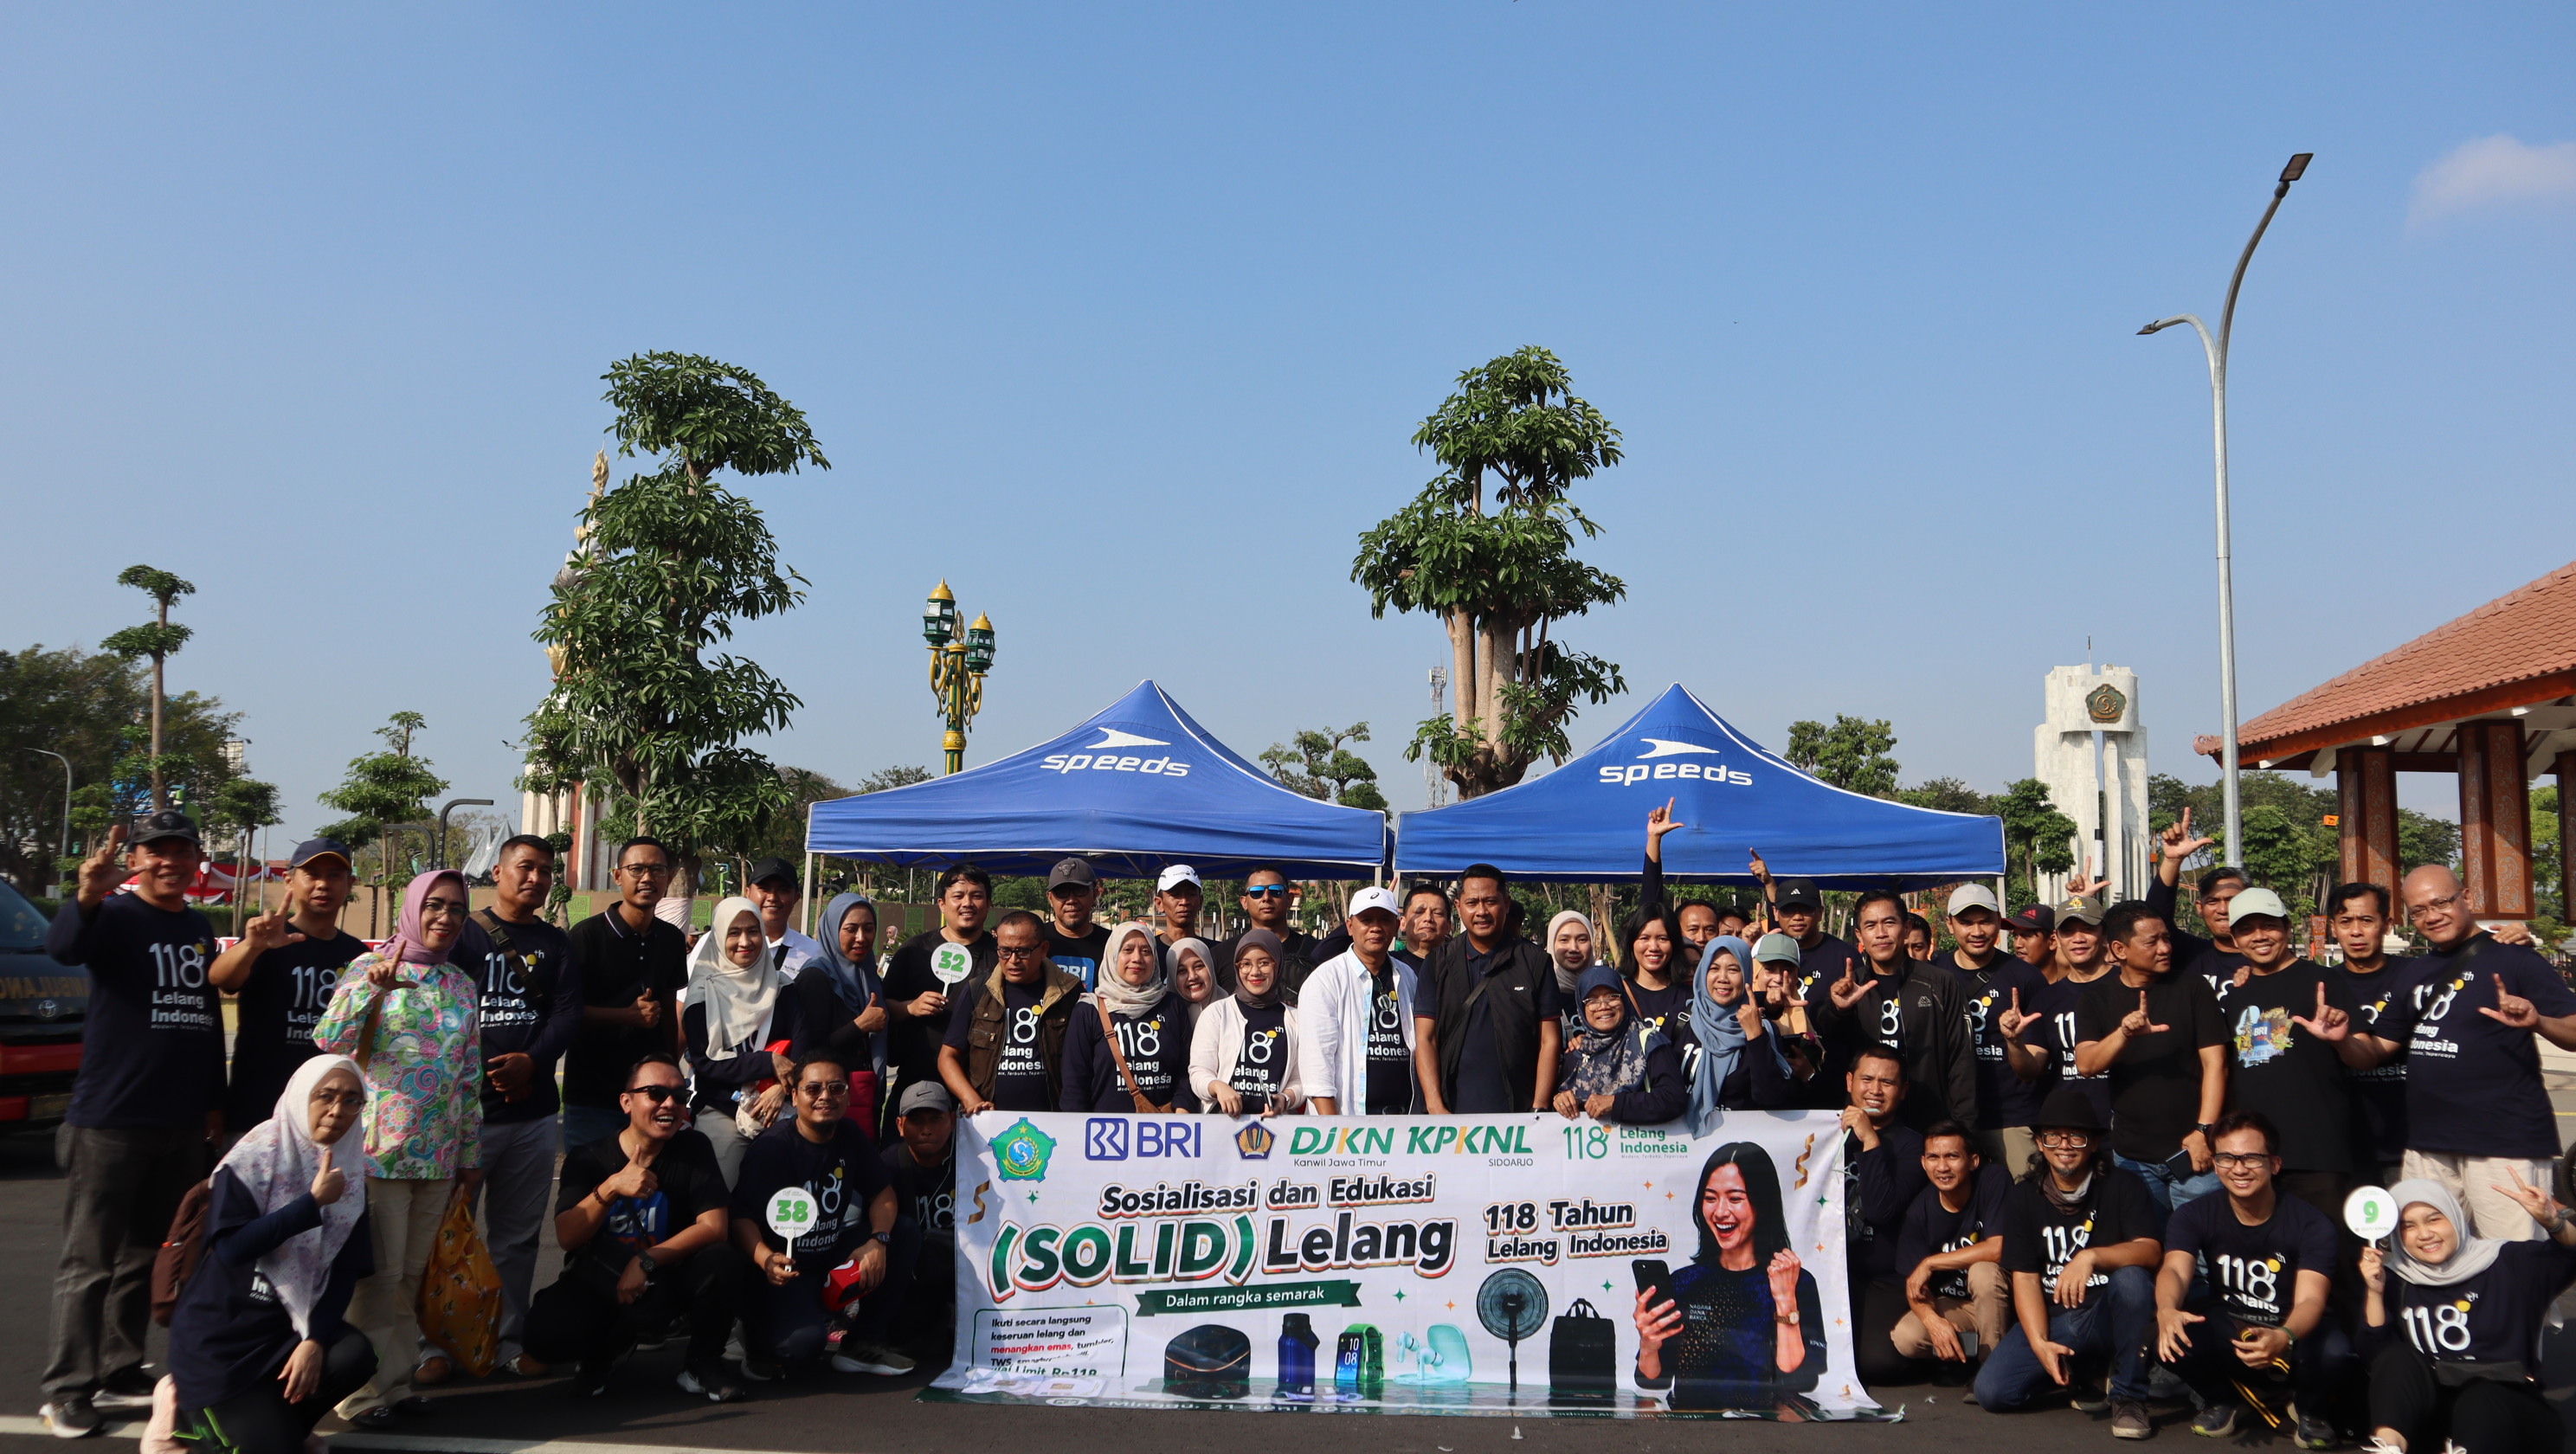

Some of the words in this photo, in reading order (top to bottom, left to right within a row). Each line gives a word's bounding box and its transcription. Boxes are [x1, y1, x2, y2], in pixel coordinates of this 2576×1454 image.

[1040, 754, 1192, 777] speeds
[1599, 763, 1753, 787] speeds
[937, 950, 966, 973] 32
[151, 990, 205, 1009] Lelang
[480, 994, 526, 1009] Lelang
[1368, 1031, 1401, 1045] elang
[2253, 1026, 2268, 1037] BRI
[1234, 1065, 1269, 1080] elang
[1137, 1122, 1201, 1158] BRI
[1407, 1125, 1534, 1155] KPKNL
[1620, 1127, 1665, 1142] Lelang
[1620, 1142, 1688, 1154] Indonesia
[1293, 1158, 1326, 1167] Kanwil
[1328, 1158, 1356, 1167] Jawa
[1358, 1158, 1388, 1167] Timur
[1488, 1158, 1534, 1168] SIDOARJO
[1102, 1180, 1257, 1214] Sosialisasi
[1269, 1181, 1319, 1206] dan
[1330, 1174, 1433, 1202] Edukasi
[776, 1200, 808, 1223] 38
[1485, 1202, 1536, 1230] 118
[1549, 1200, 1633, 1226] Tahun
[2363, 1200, 2380, 1224] 9
[1488, 1235, 1558, 1260] Lelang
[1569, 1228, 1667, 1253] Indonesia
[991, 1215, 1255, 1296] (SOLID)
[1266, 1213, 1454, 1274] Lelang
[1166, 1294, 1209, 1308] Dalam
[1213, 1290, 1261, 1308] rangka
[1265, 1285, 1324, 1302] semarak
[991, 1318, 1013, 1328] Ikuti
[1015, 1318, 1046, 1327] secara
[1048, 1316, 1092, 1327] langsung
[990, 1331, 1034, 1341] keseruan
[1036, 1329, 1066, 1341] lelang
[1067, 1328, 1085, 1337] dan
[990, 1343, 1045, 1354] menangkan
[1349, 1337, 1360, 1351] 10
[1344, 1351, 1358, 1366] 08
